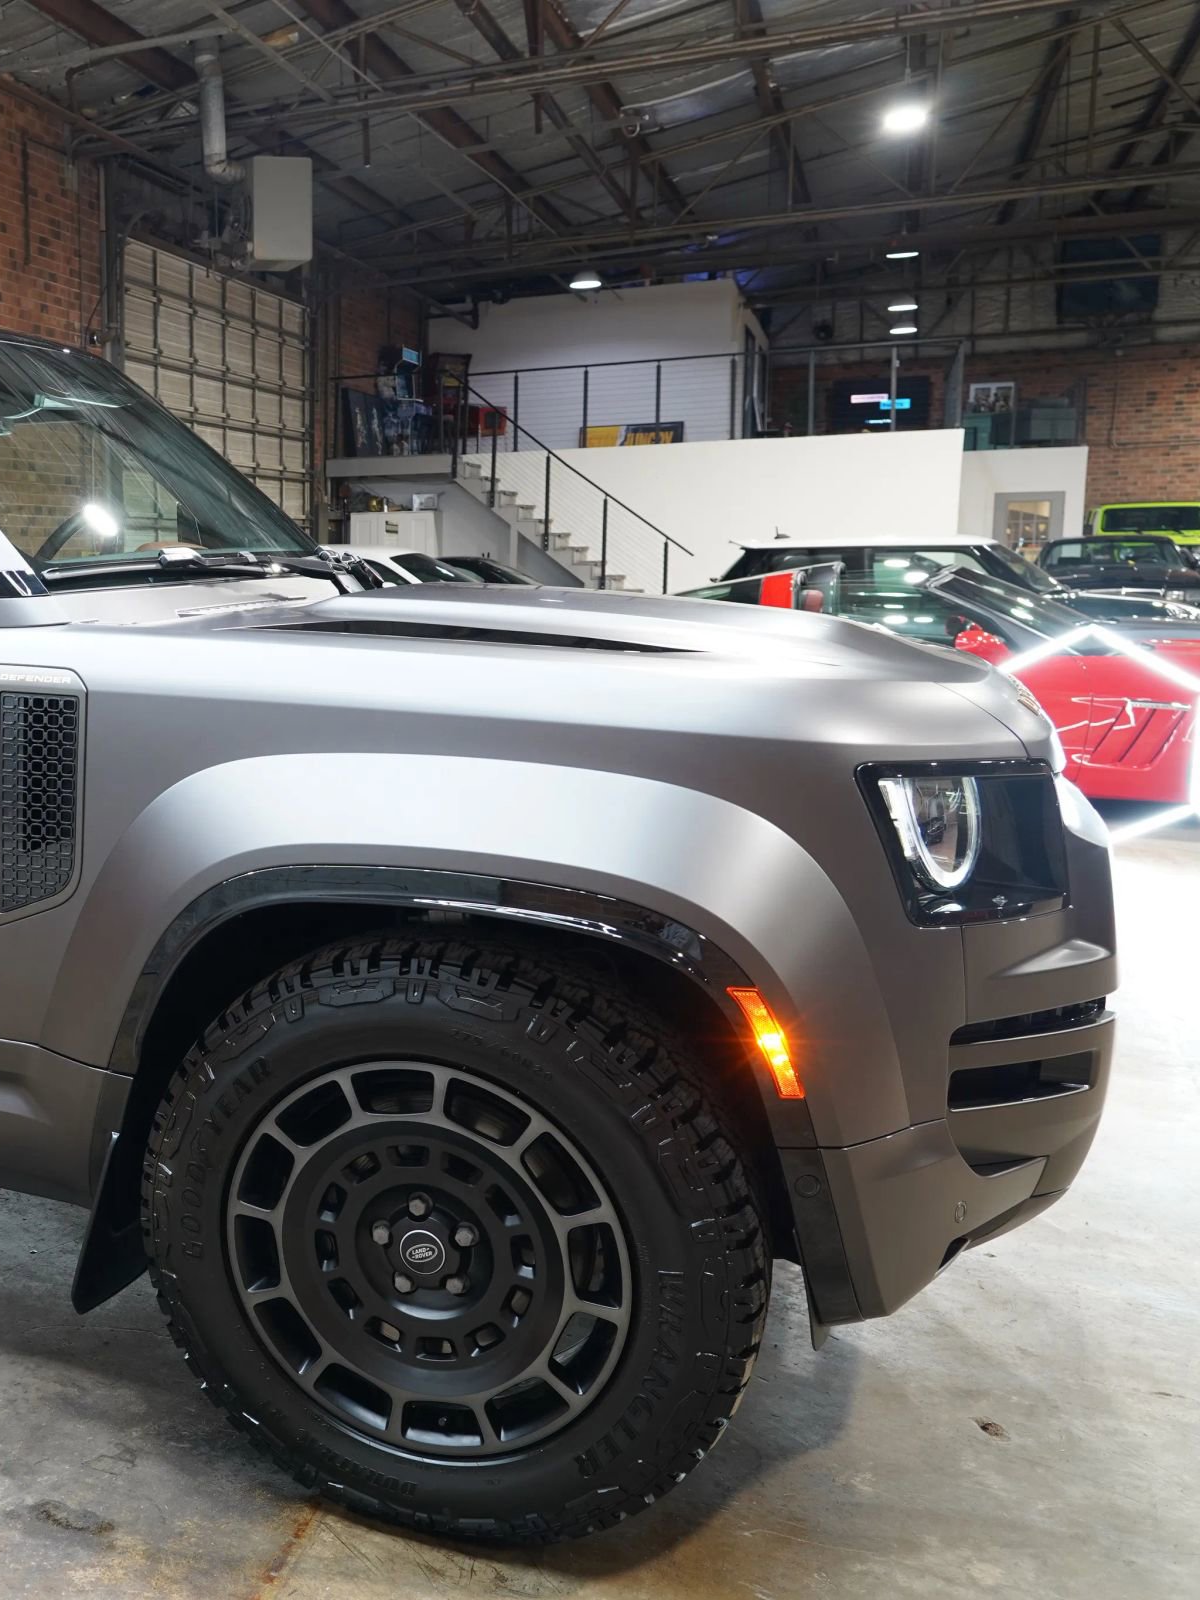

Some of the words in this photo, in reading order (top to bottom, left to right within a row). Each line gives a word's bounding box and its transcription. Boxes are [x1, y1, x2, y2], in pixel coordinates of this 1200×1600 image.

[0, 674, 71, 684] DEFENDER
[412, 1247, 427, 1255] LAND
[414, 1251, 433, 1260] ROVER
[574, 1269, 688, 1478] WRANGLER
